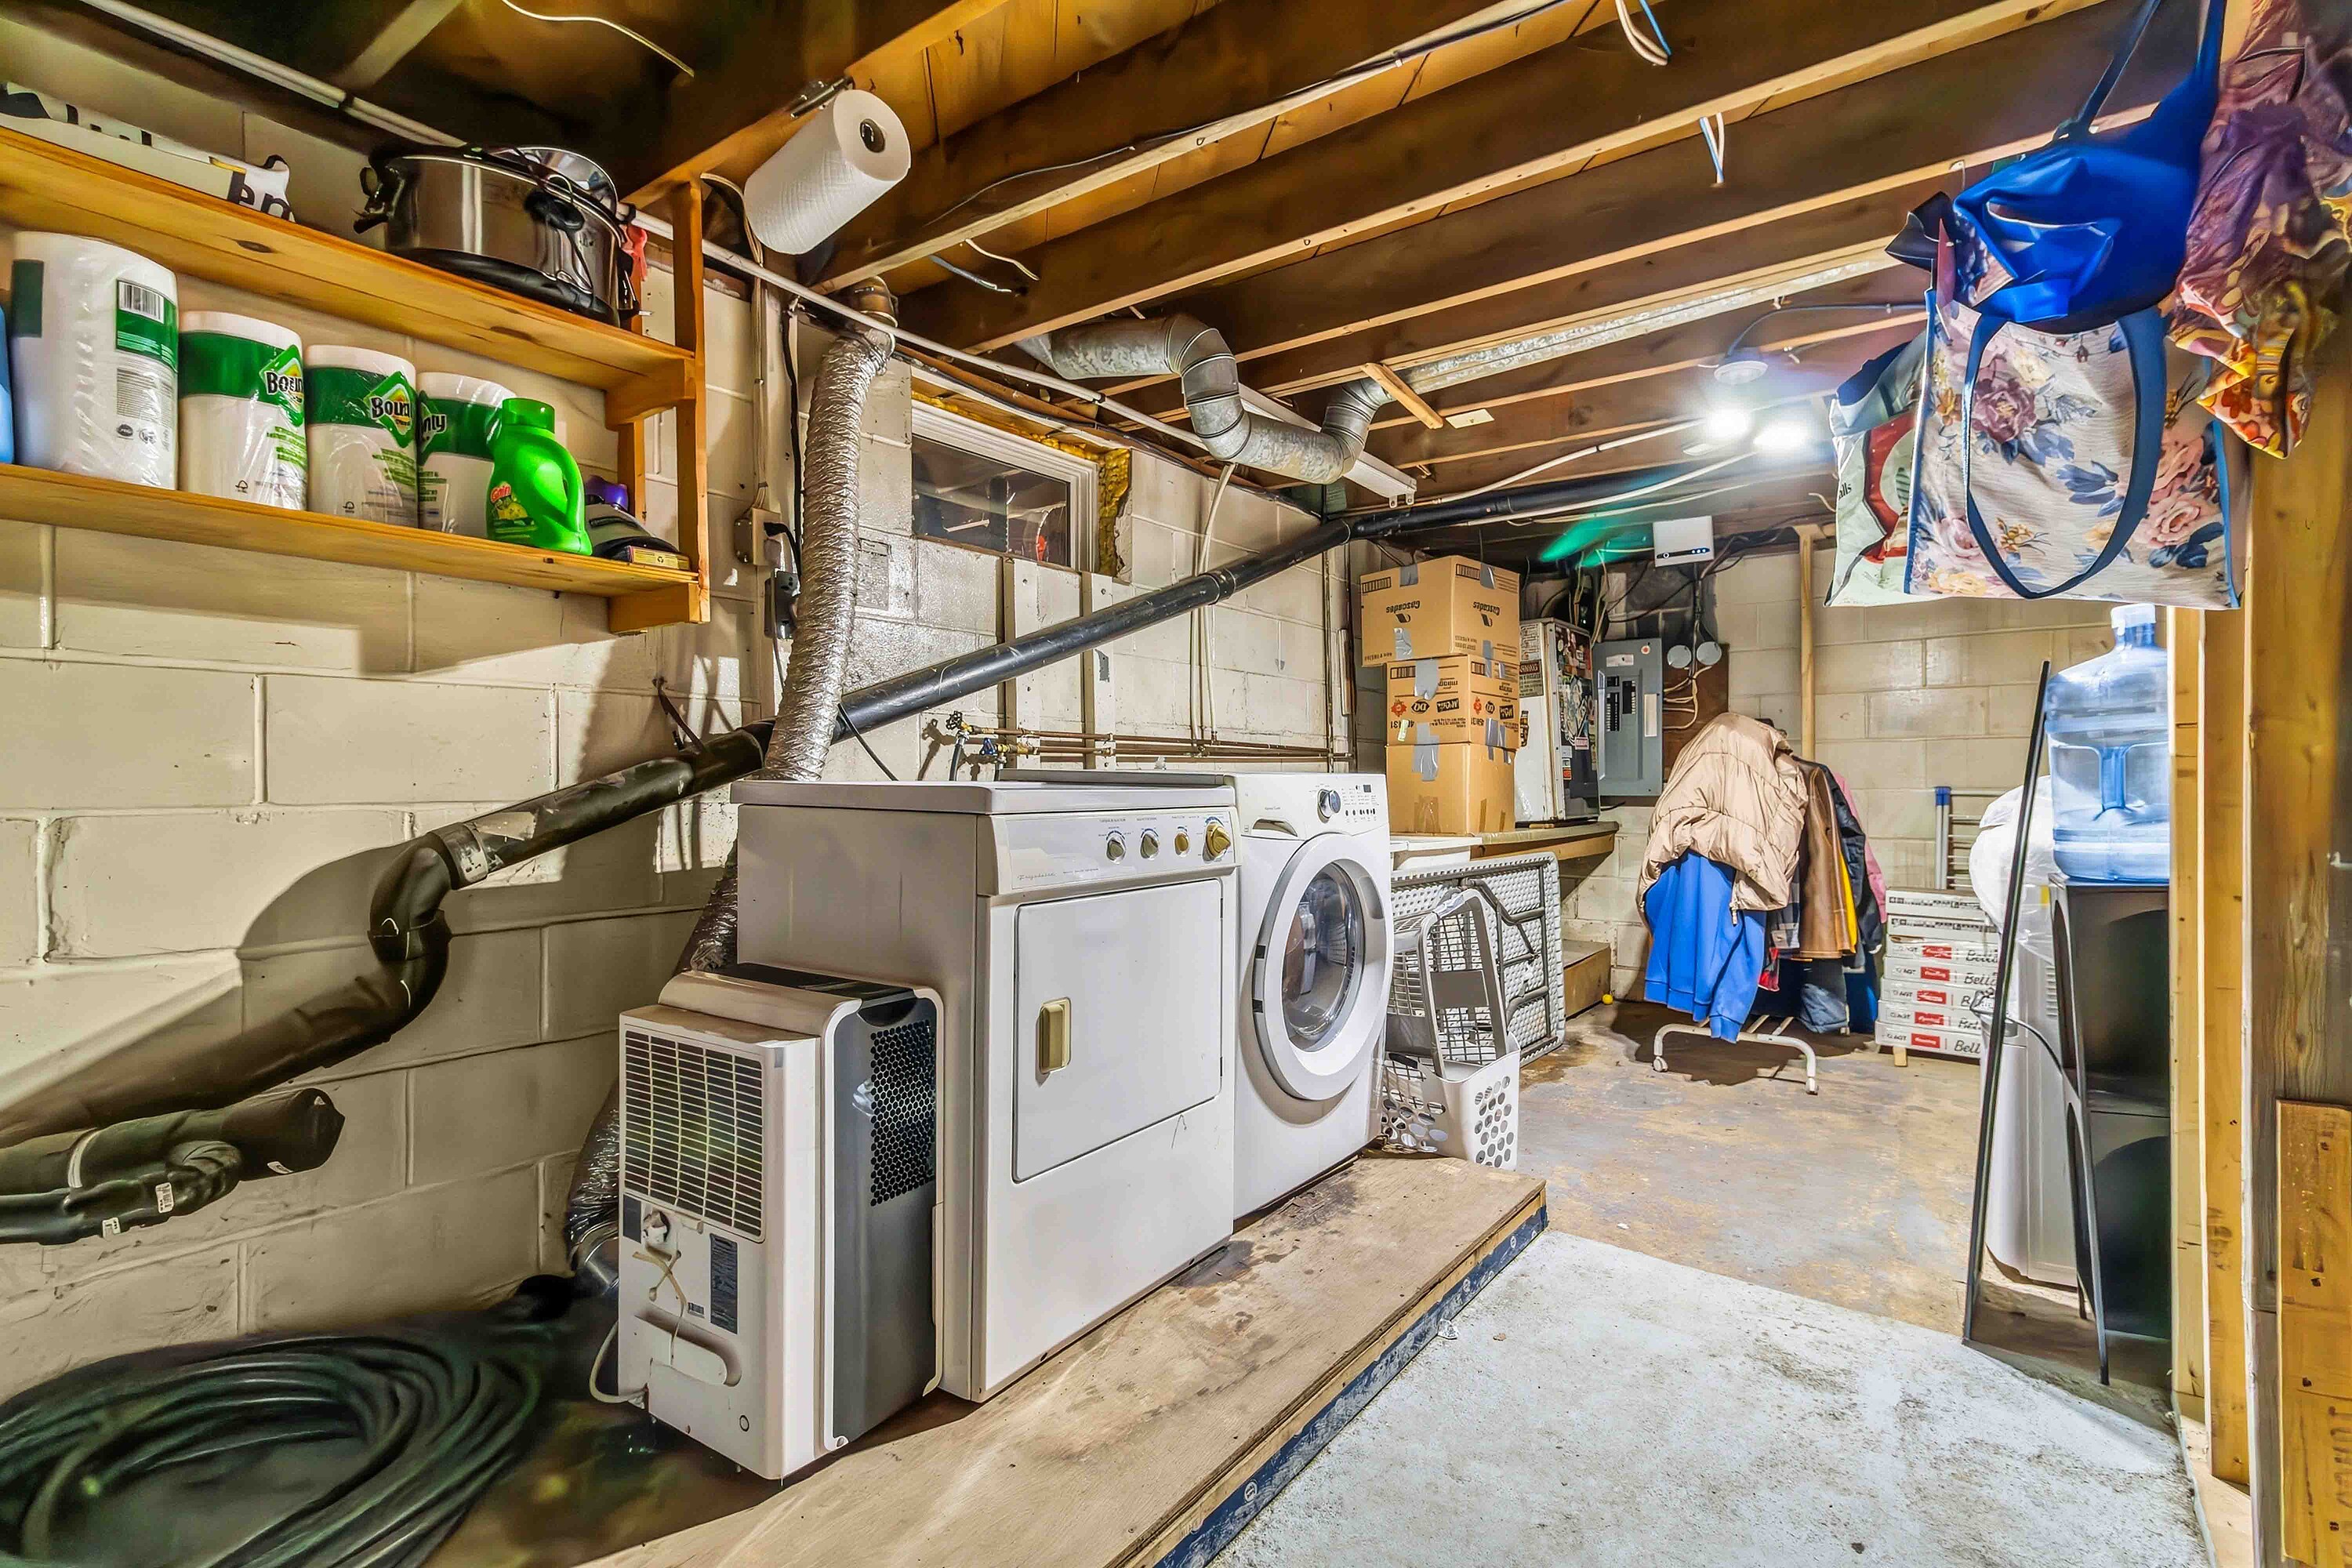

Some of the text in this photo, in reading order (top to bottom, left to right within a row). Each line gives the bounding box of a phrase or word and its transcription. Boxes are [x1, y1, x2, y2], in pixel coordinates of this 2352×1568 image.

[1385, 601, 1421, 614] Cascades
[1472, 601, 1501, 615] Cascades
[1955, 1040, 1981, 1054] Bell
